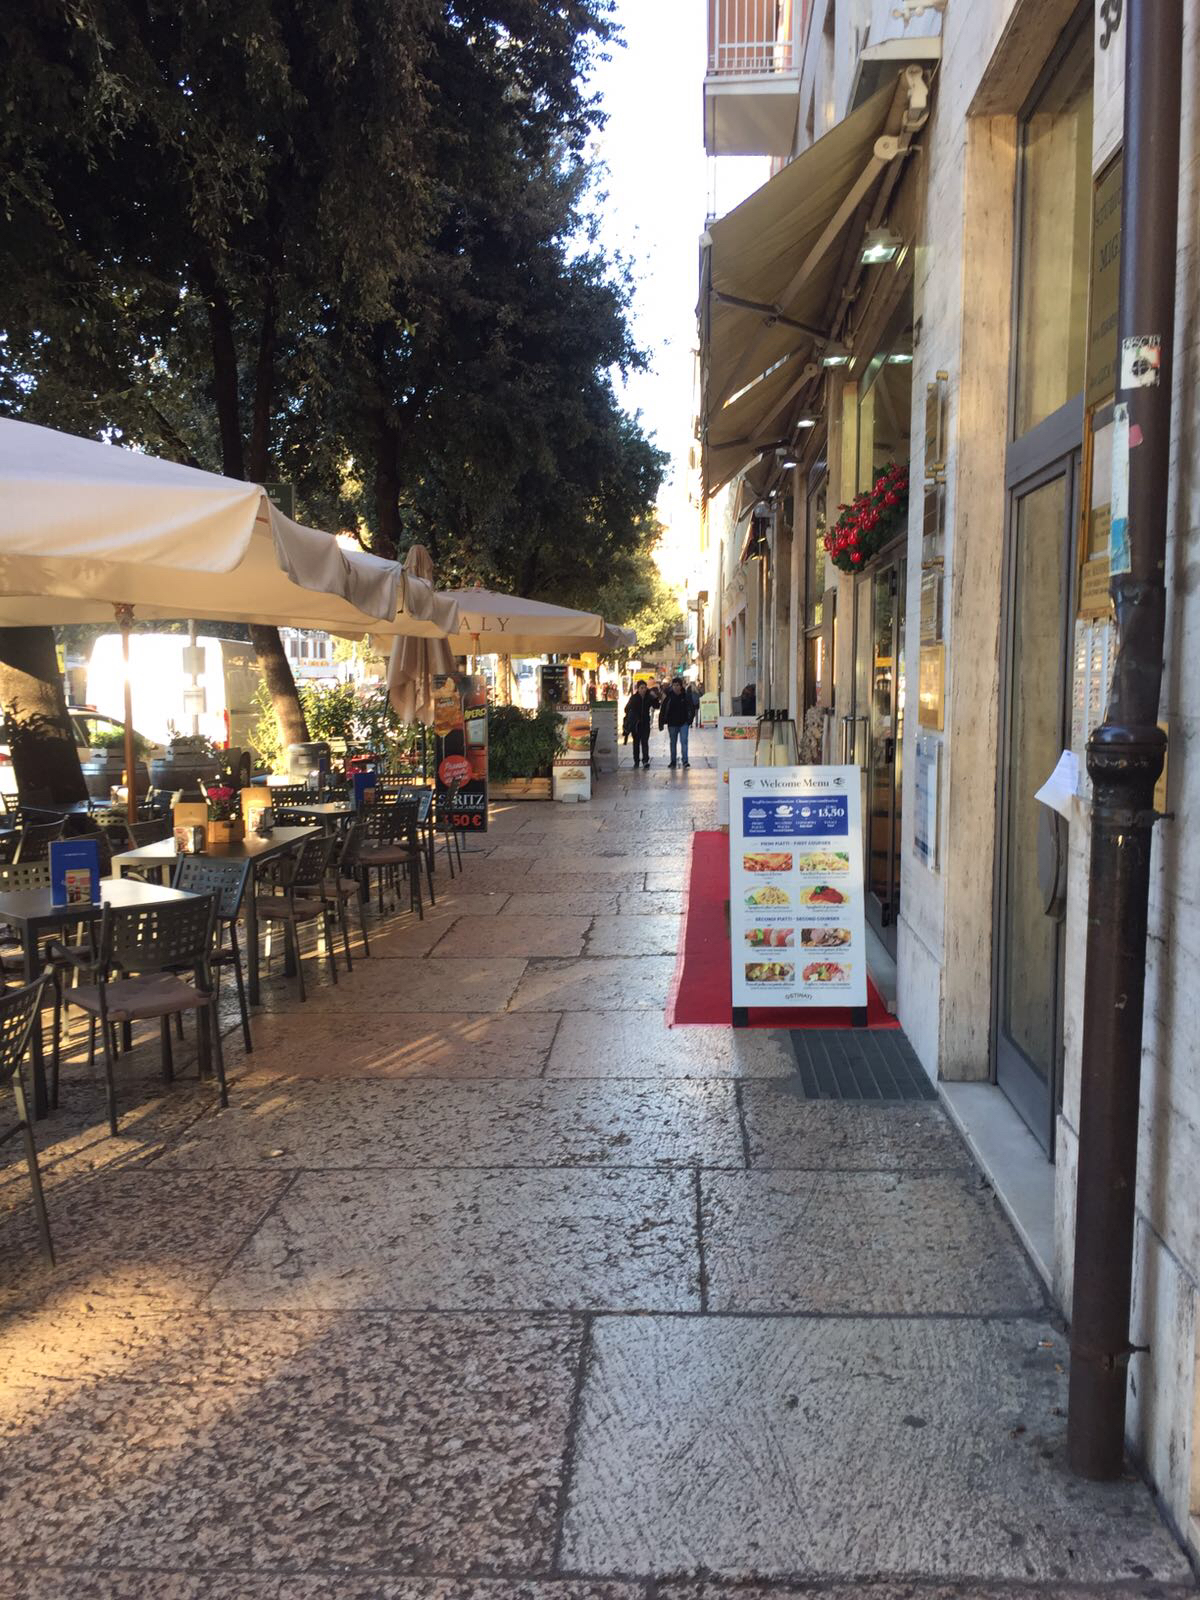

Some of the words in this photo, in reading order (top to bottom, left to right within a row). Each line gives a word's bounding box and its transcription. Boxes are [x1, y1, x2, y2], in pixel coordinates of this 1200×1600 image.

[760, 779, 802, 788] Welcome
[803, 778, 830, 787] Menu
[438, 794, 484, 806] SRITZ
[818, 807, 845, 818] 13,50
